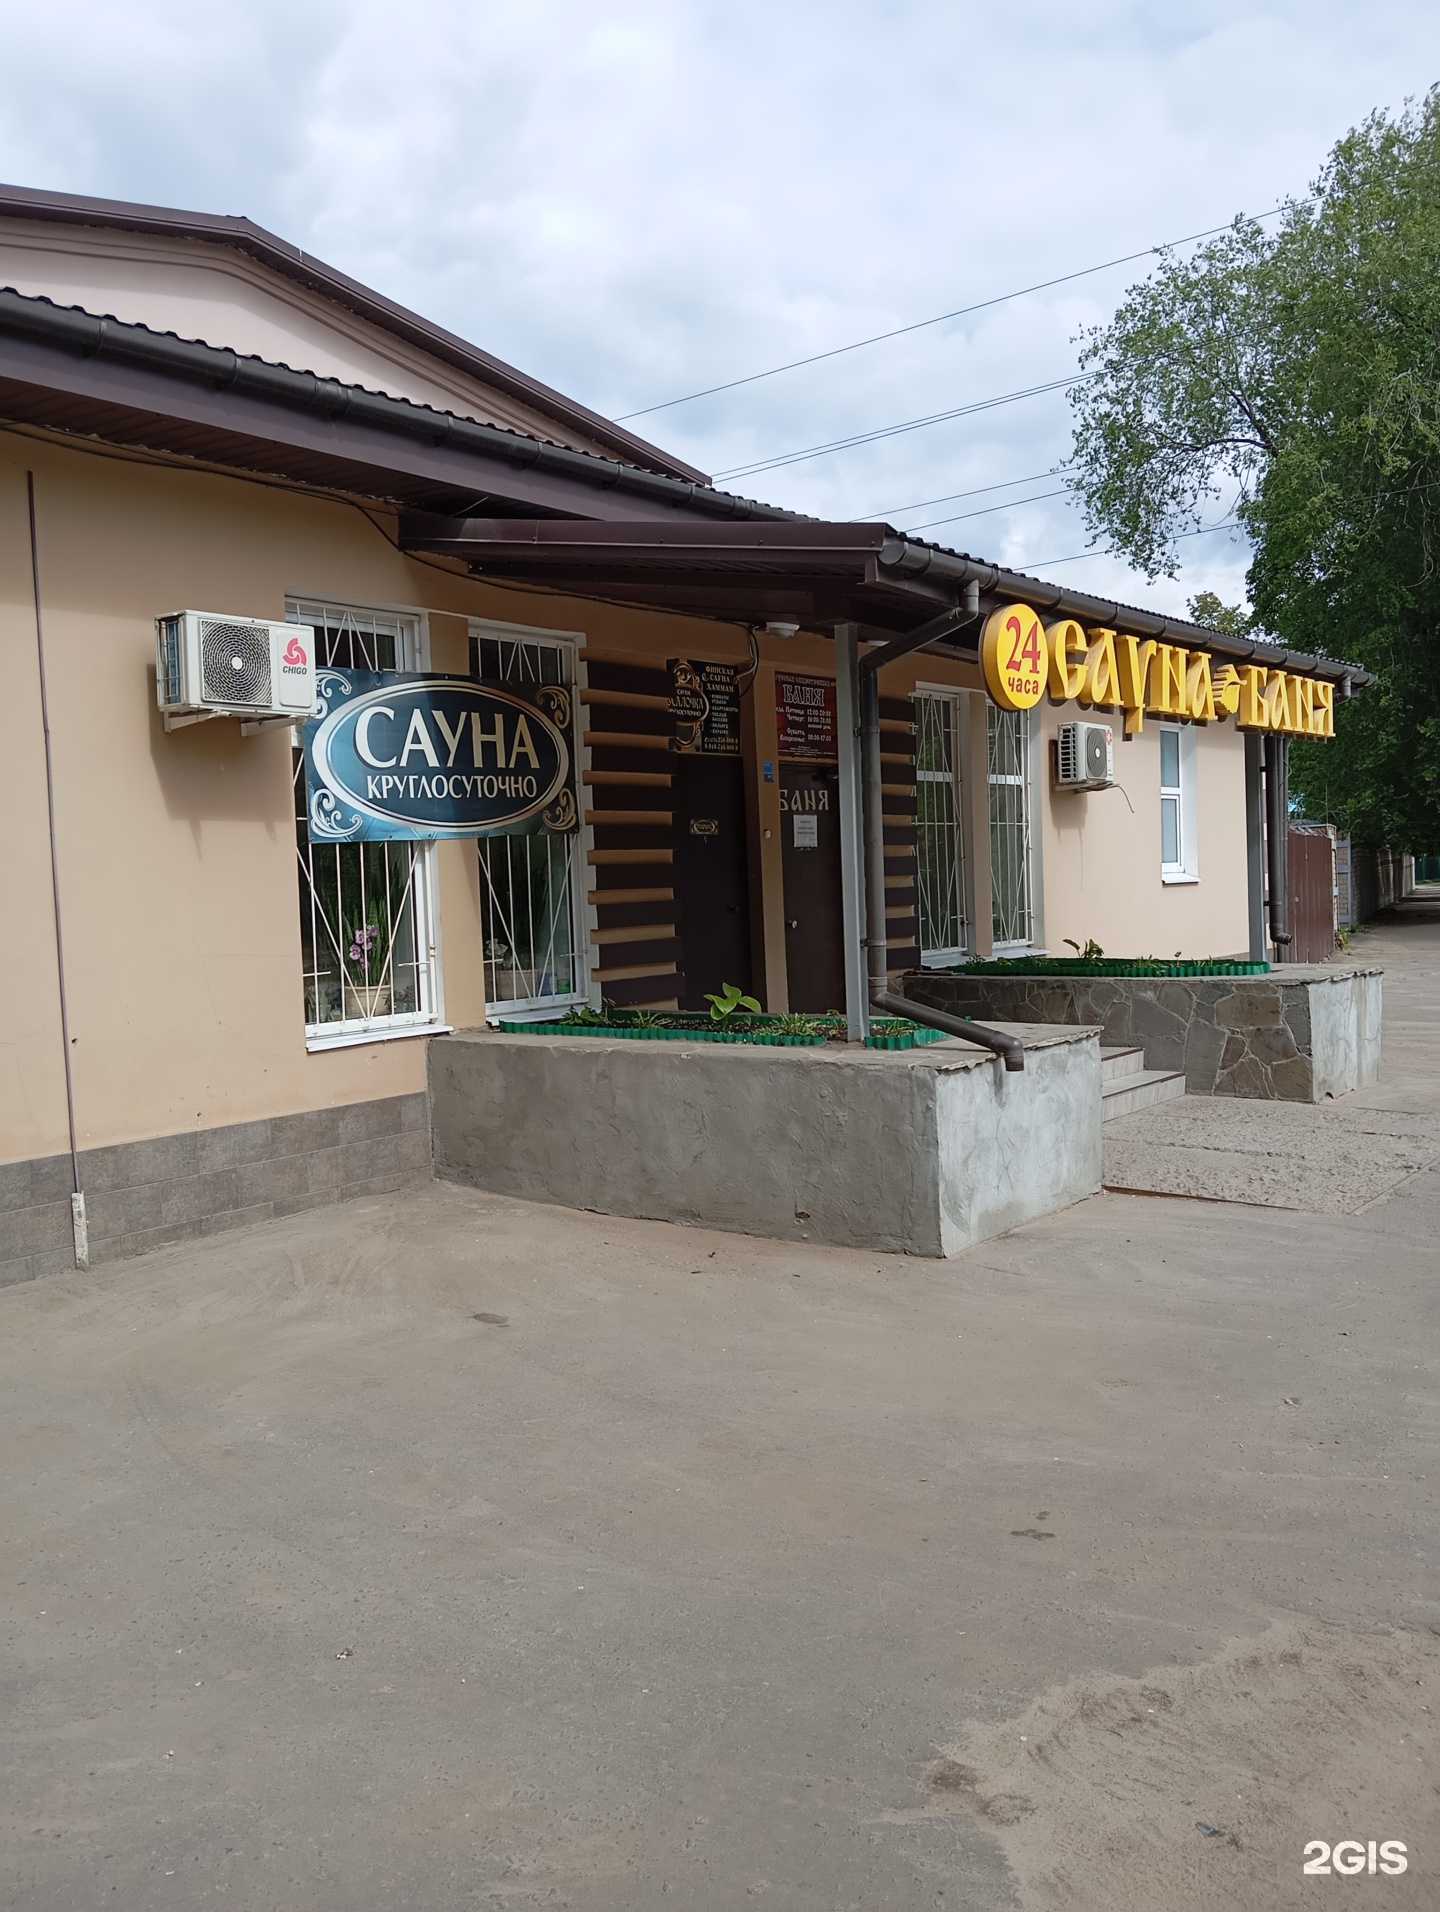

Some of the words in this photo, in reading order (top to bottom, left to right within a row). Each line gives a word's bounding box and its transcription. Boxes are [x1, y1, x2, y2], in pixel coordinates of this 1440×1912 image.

[1006, 615, 1041, 674] 24
[282, 666, 308, 675] CHIGO
[1051, 620, 1217, 733] САУНА
[1238, 664, 1335, 737] БАНЯ
[782, 683, 825, 706] БАНЯ
[1008, 674, 1039, 695] часа
[355, 706, 540, 769] САУНА
[366, 775, 537, 799] КРУГЛОСУТОЧНО
[779, 789, 829, 811] БАНЯ
